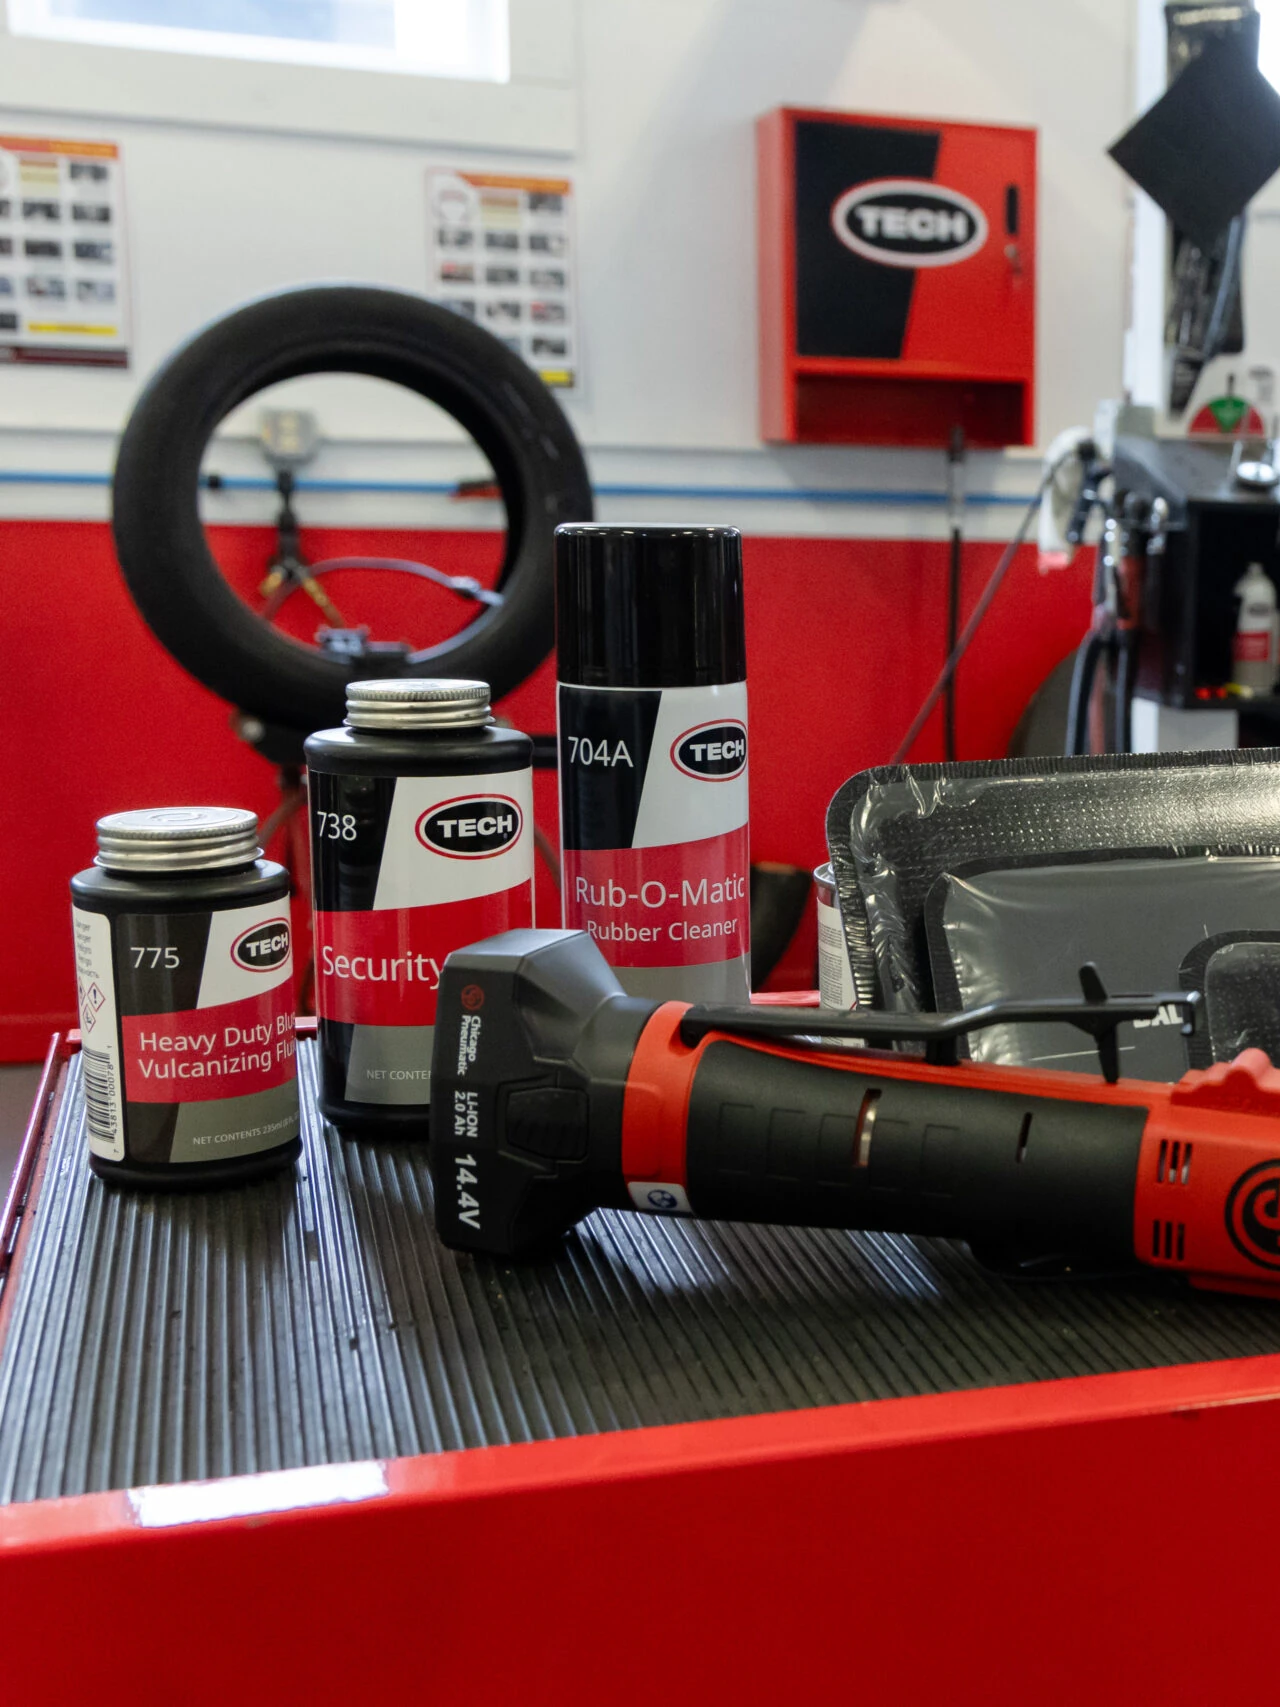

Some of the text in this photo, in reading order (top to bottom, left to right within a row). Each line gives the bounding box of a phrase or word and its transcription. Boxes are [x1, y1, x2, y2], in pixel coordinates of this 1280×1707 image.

[854, 205, 967, 242] TECH
[567, 736, 634, 768] 704A
[689, 738, 745, 762] TECH
[316, 811, 358, 841] 738
[437, 813, 513, 838] TECH
[576, 873, 745, 908] Rub-O-Matic
[246, 931, 289, 957] TECH
[587, 918, 738, 942] Rubber Cleaner
[130, 946, 181, 969] 775
[322, 945, 440, 990] Security
[140, 1031, 217, 1055] Heavy
[224, 1023, 273, 1047] Duty
[457, 1014, 472, 1076] Pneumatic
[468, 1015, 482, 1062] Chicago
[138, 1050, 272, 1079] Vulcanizing
[366, 1069, 387, 1080] NET
[454, 1091, 466, 1136] 2.0 Ah
[193, 1136, 212, 1145] NET
[214, 1127, 261, 1143] CONTENTS
[454, 1153, 481, 1230] 14.4V
